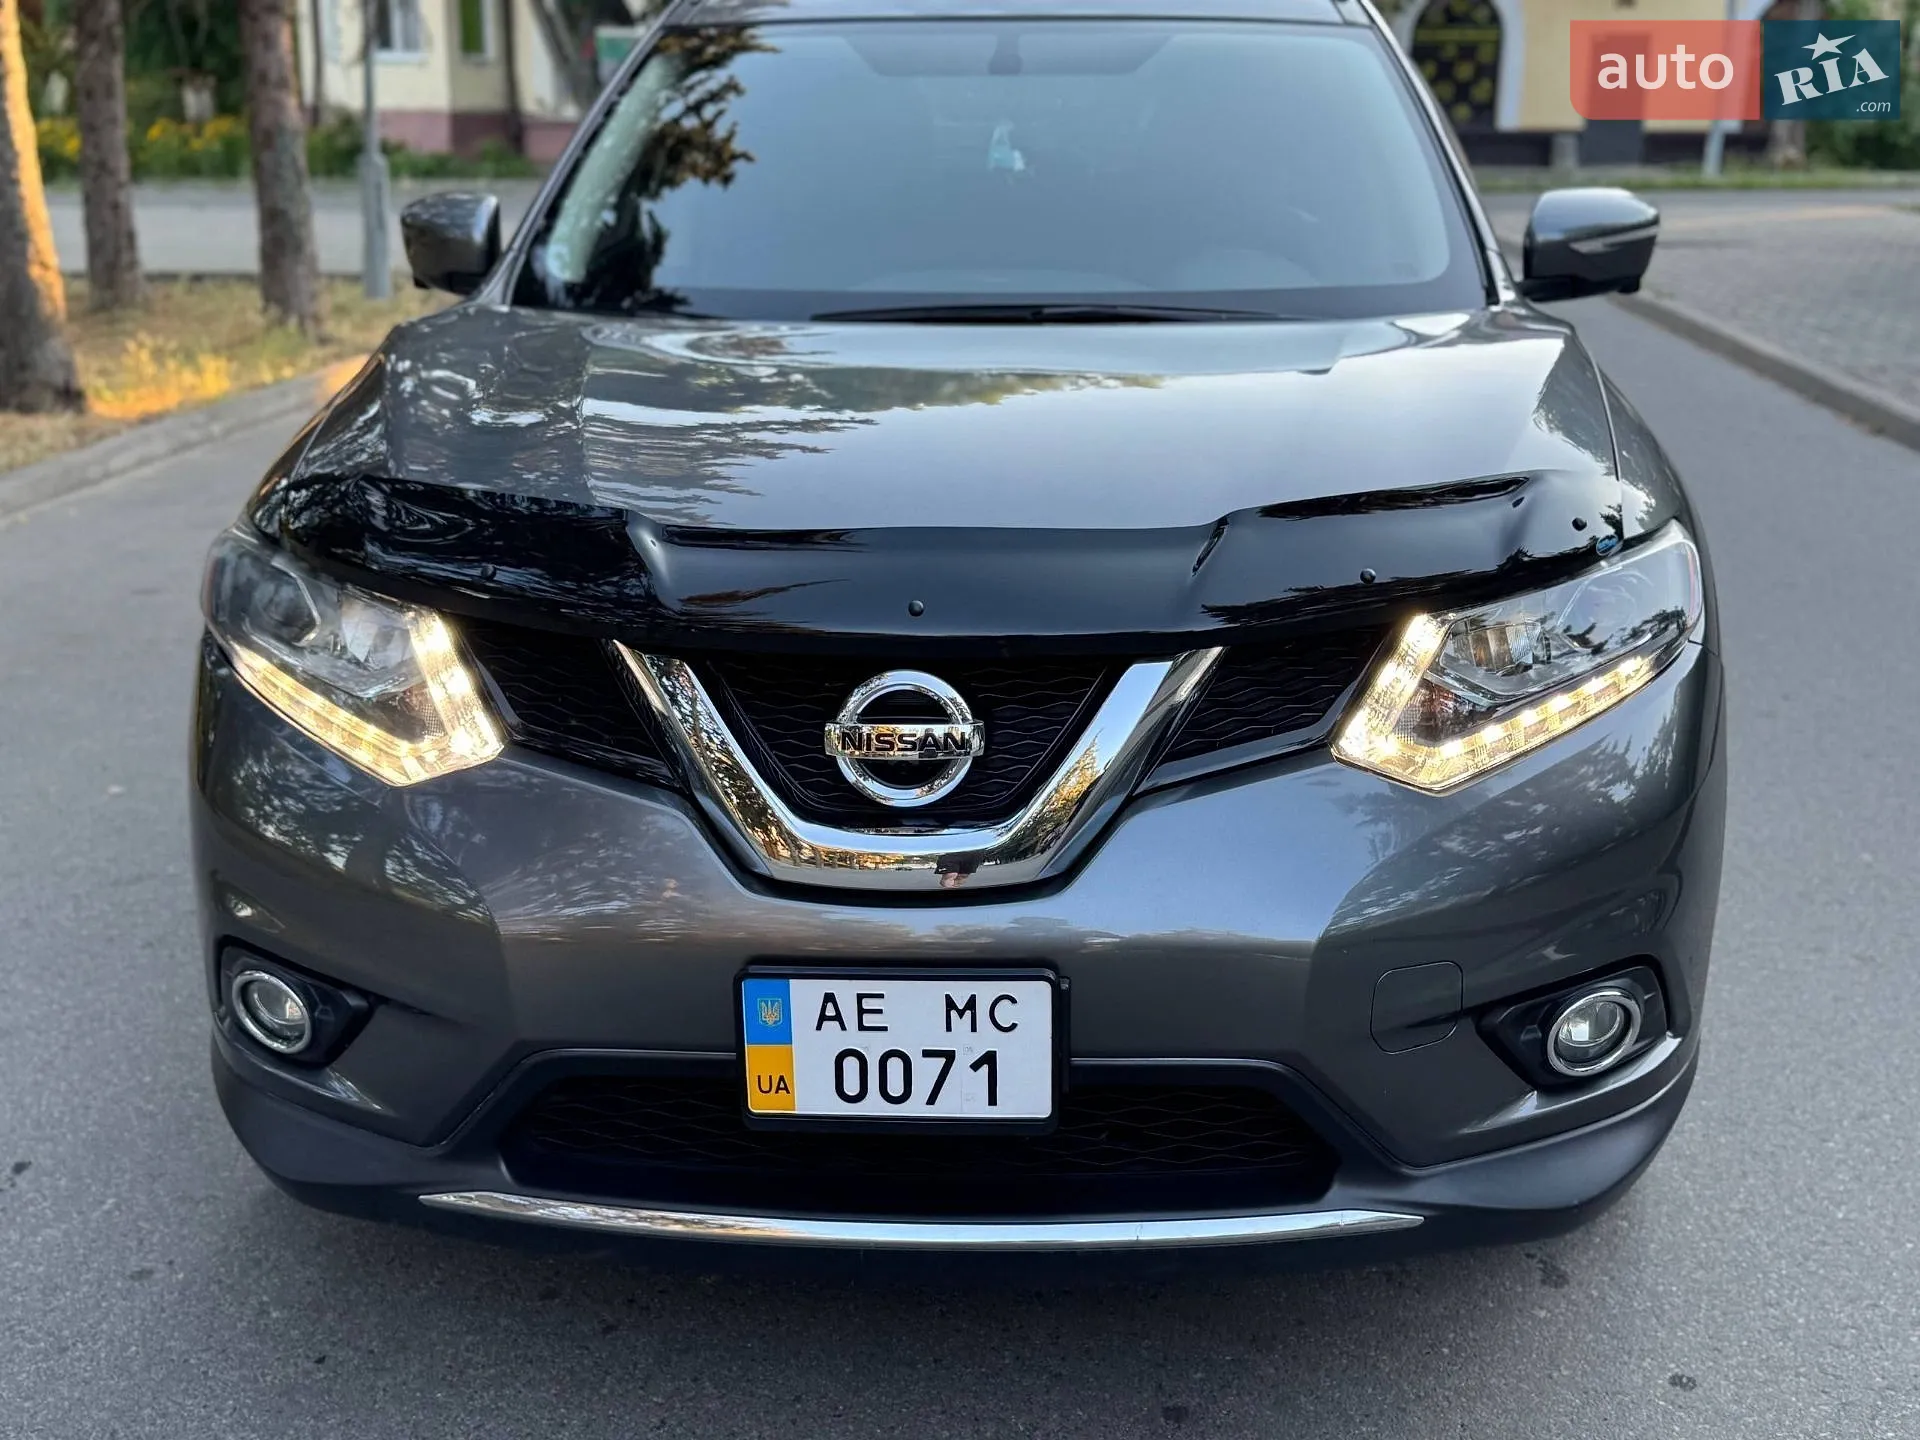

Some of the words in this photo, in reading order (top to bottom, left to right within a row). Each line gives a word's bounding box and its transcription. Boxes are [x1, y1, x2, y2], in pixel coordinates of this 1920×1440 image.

[840, 731, 966, 752] NISSAN
[815, 991, 889, 1032] AE
[944, 993, 1019, 1033] MC
[757, 1074, 791, 1095] UA
[834, 1047, 999, 1107] 0071
